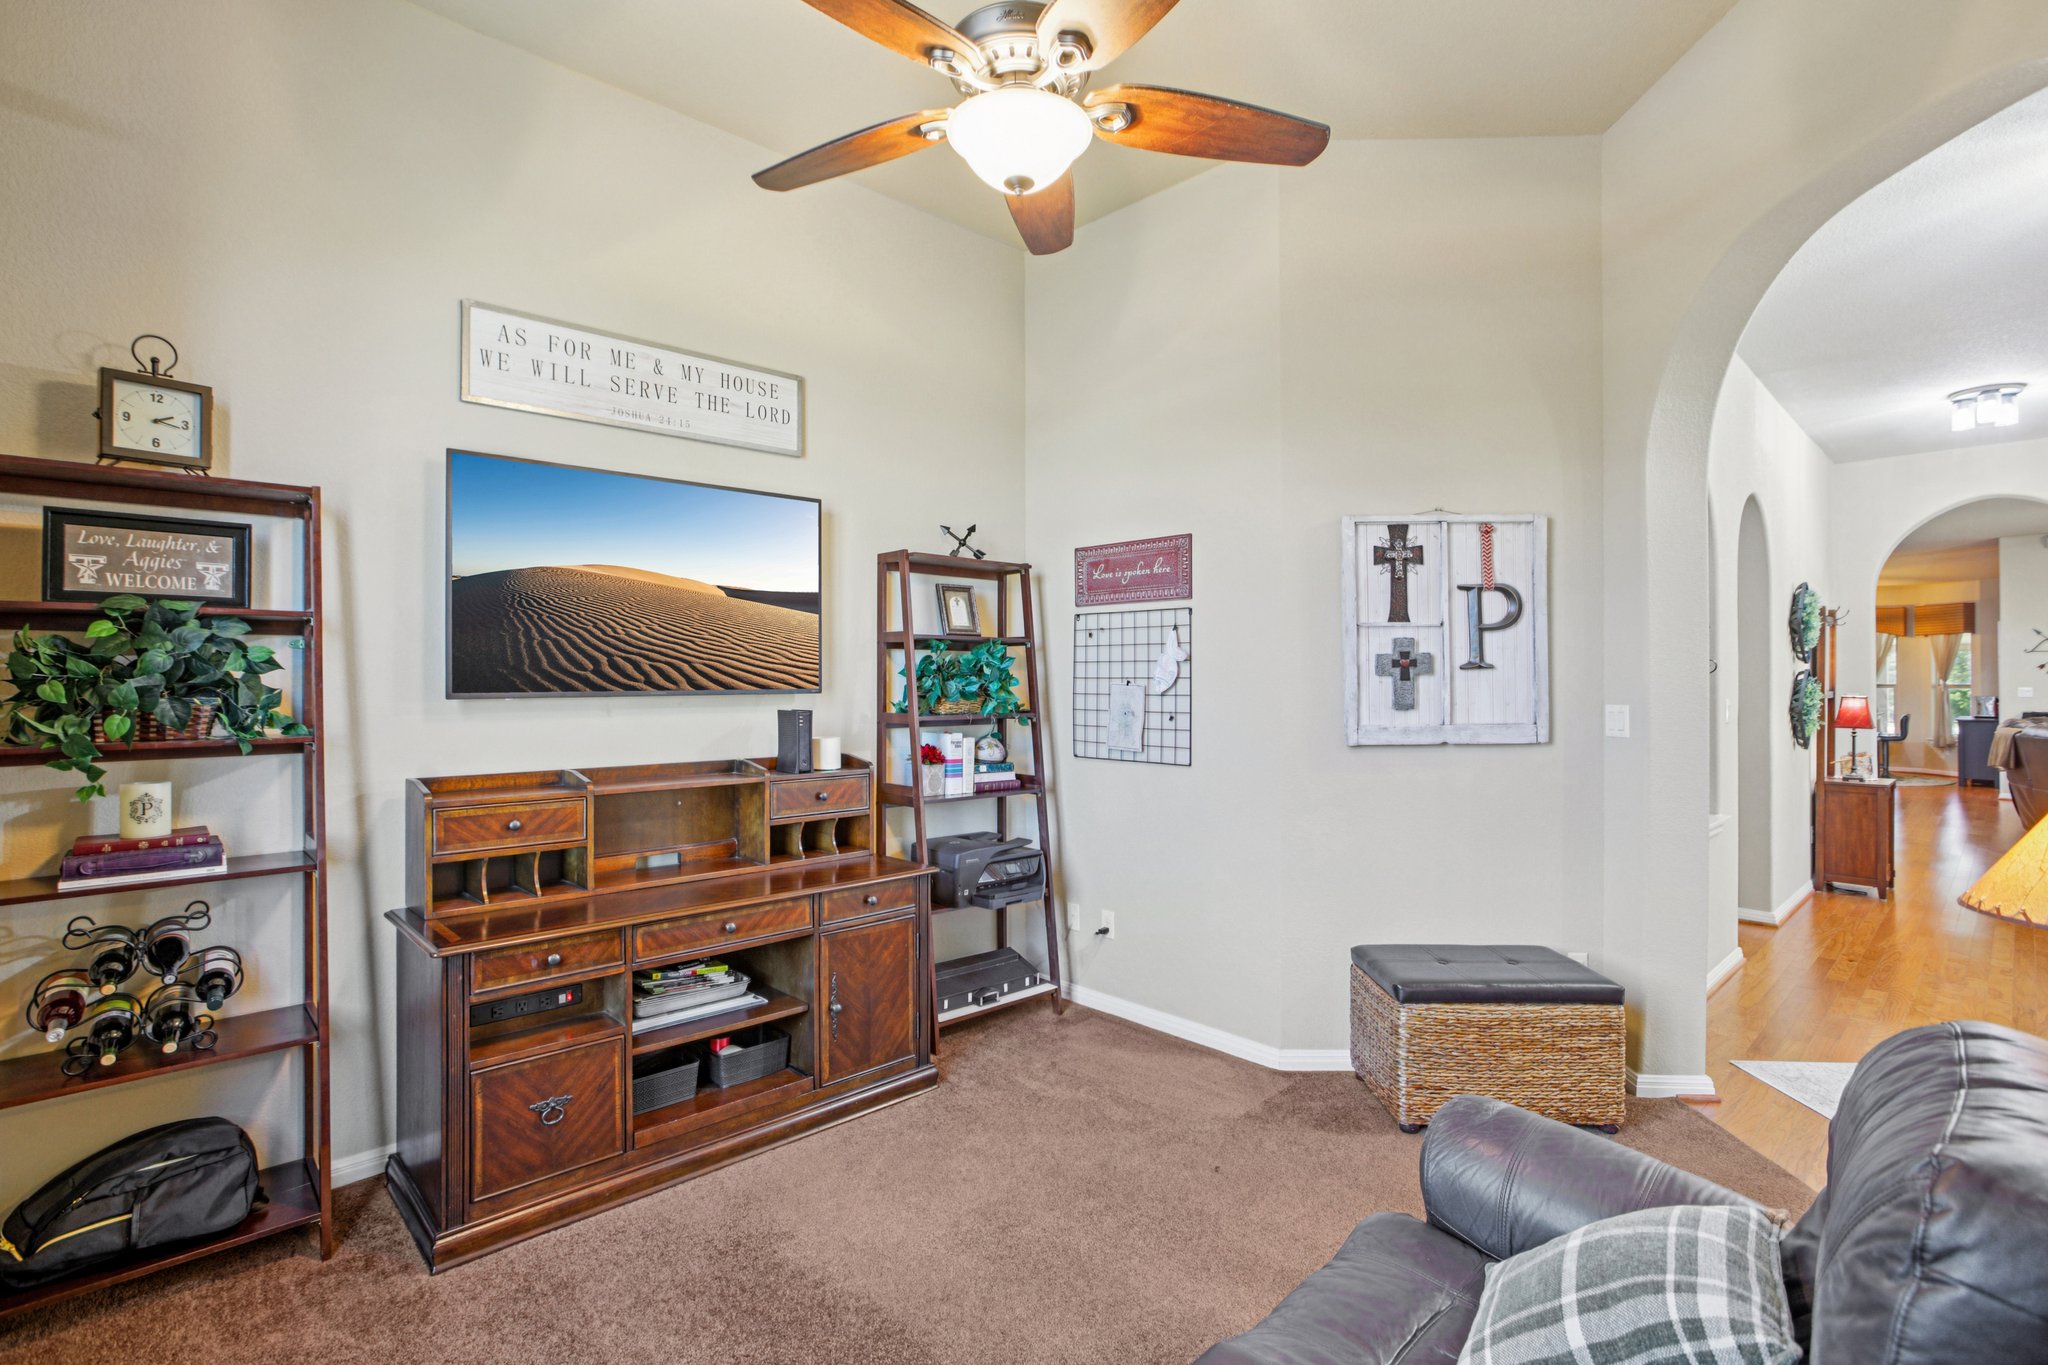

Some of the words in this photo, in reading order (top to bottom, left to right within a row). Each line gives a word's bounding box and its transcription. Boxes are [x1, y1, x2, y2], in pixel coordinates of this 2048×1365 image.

[497, 324, 527, 347] AS
[548, 334, 591, 361] FOR
[610, 348, 636, 370] ME
[653, 358, 664, 376] &
[681, 363, 704, 384] MY
[721, 372, 779, 400] HOUSE
[480, 348, 511, 372] WE
[531, 358, 591, 388] WILL
[610, 375, 678, 404] SERVE
[695, 391, 730, 414] THE
[745, 401, 791, 425] LORD
[150, 393, 164, 404] 12
[122, 411, 131, 422] 9
[181, 420, 190, 431] 3
[611, 406, 651, 422] JOSHUA
[658, 415, 691, 428] 24:15
[151, 437, 160, 448] 6
[77, 529, 120, 548] Love,
[125, 533, 201, 555] Laughter,
[205, 540, 222, 554] &
[122, 551, 188, 574] Aggies
[1092, 563, 1113, 580] Love
[1115, 567, 1122, 577] is
[1121, 561, 1151, 585] spoken
[1153, 556, 1171, 574] here
[104, 572, 197, 591] WELCOME
[1456, 582, 1523, 670] P
[141, 802, 153, 816] P
